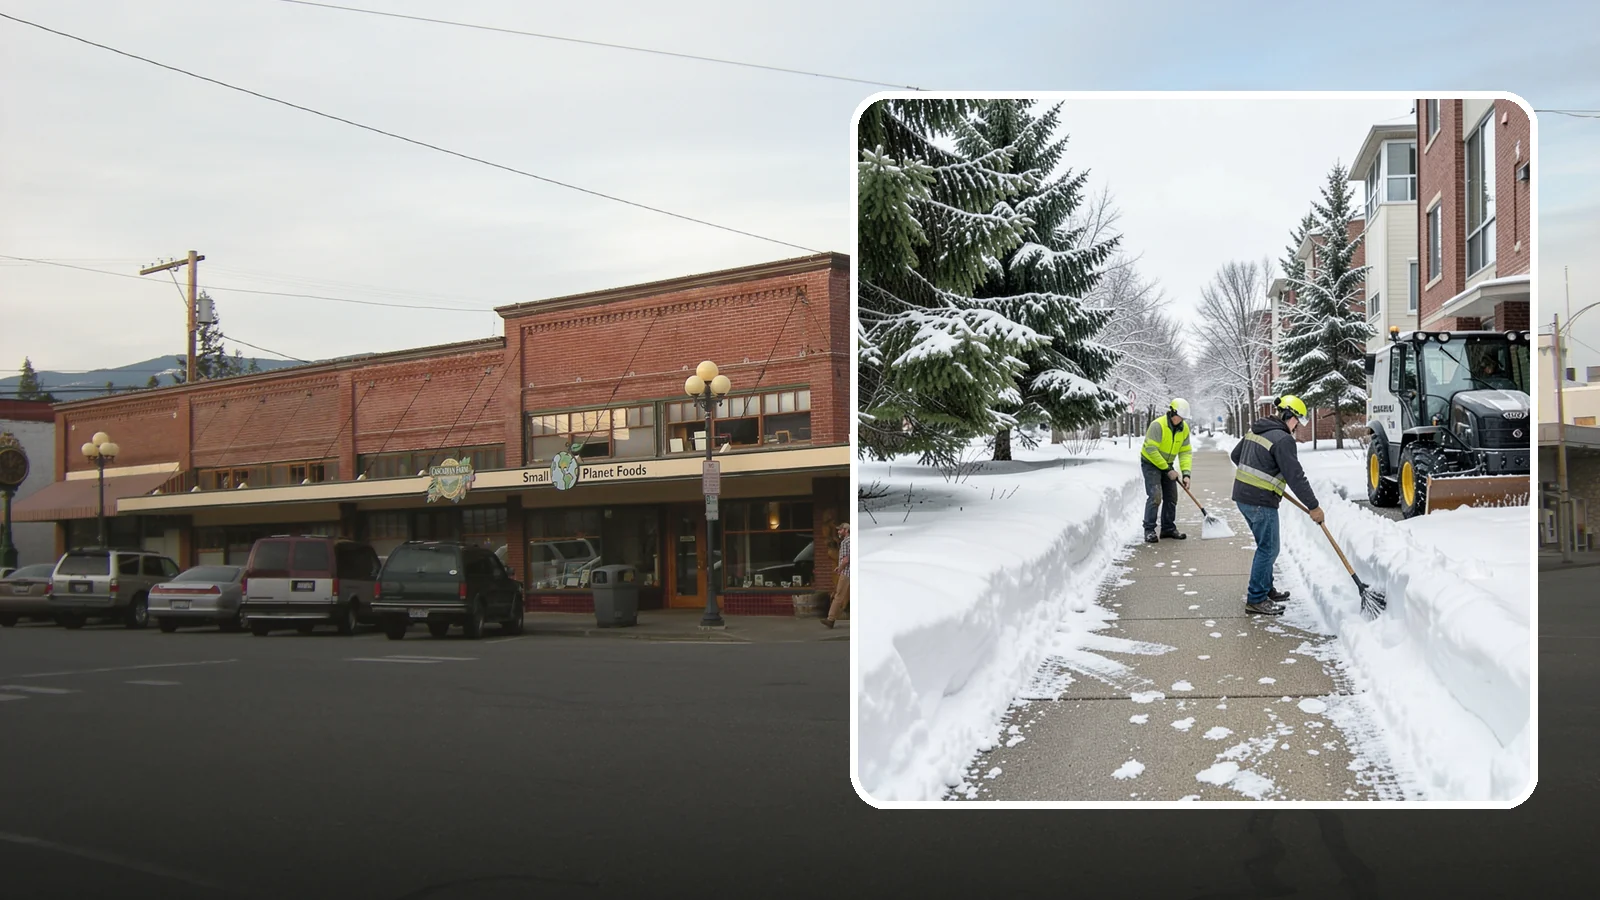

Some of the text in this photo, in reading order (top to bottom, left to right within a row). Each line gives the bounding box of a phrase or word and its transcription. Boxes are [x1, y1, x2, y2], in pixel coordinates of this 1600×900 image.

[523, 464, 647, 483] Small Planet Foods
